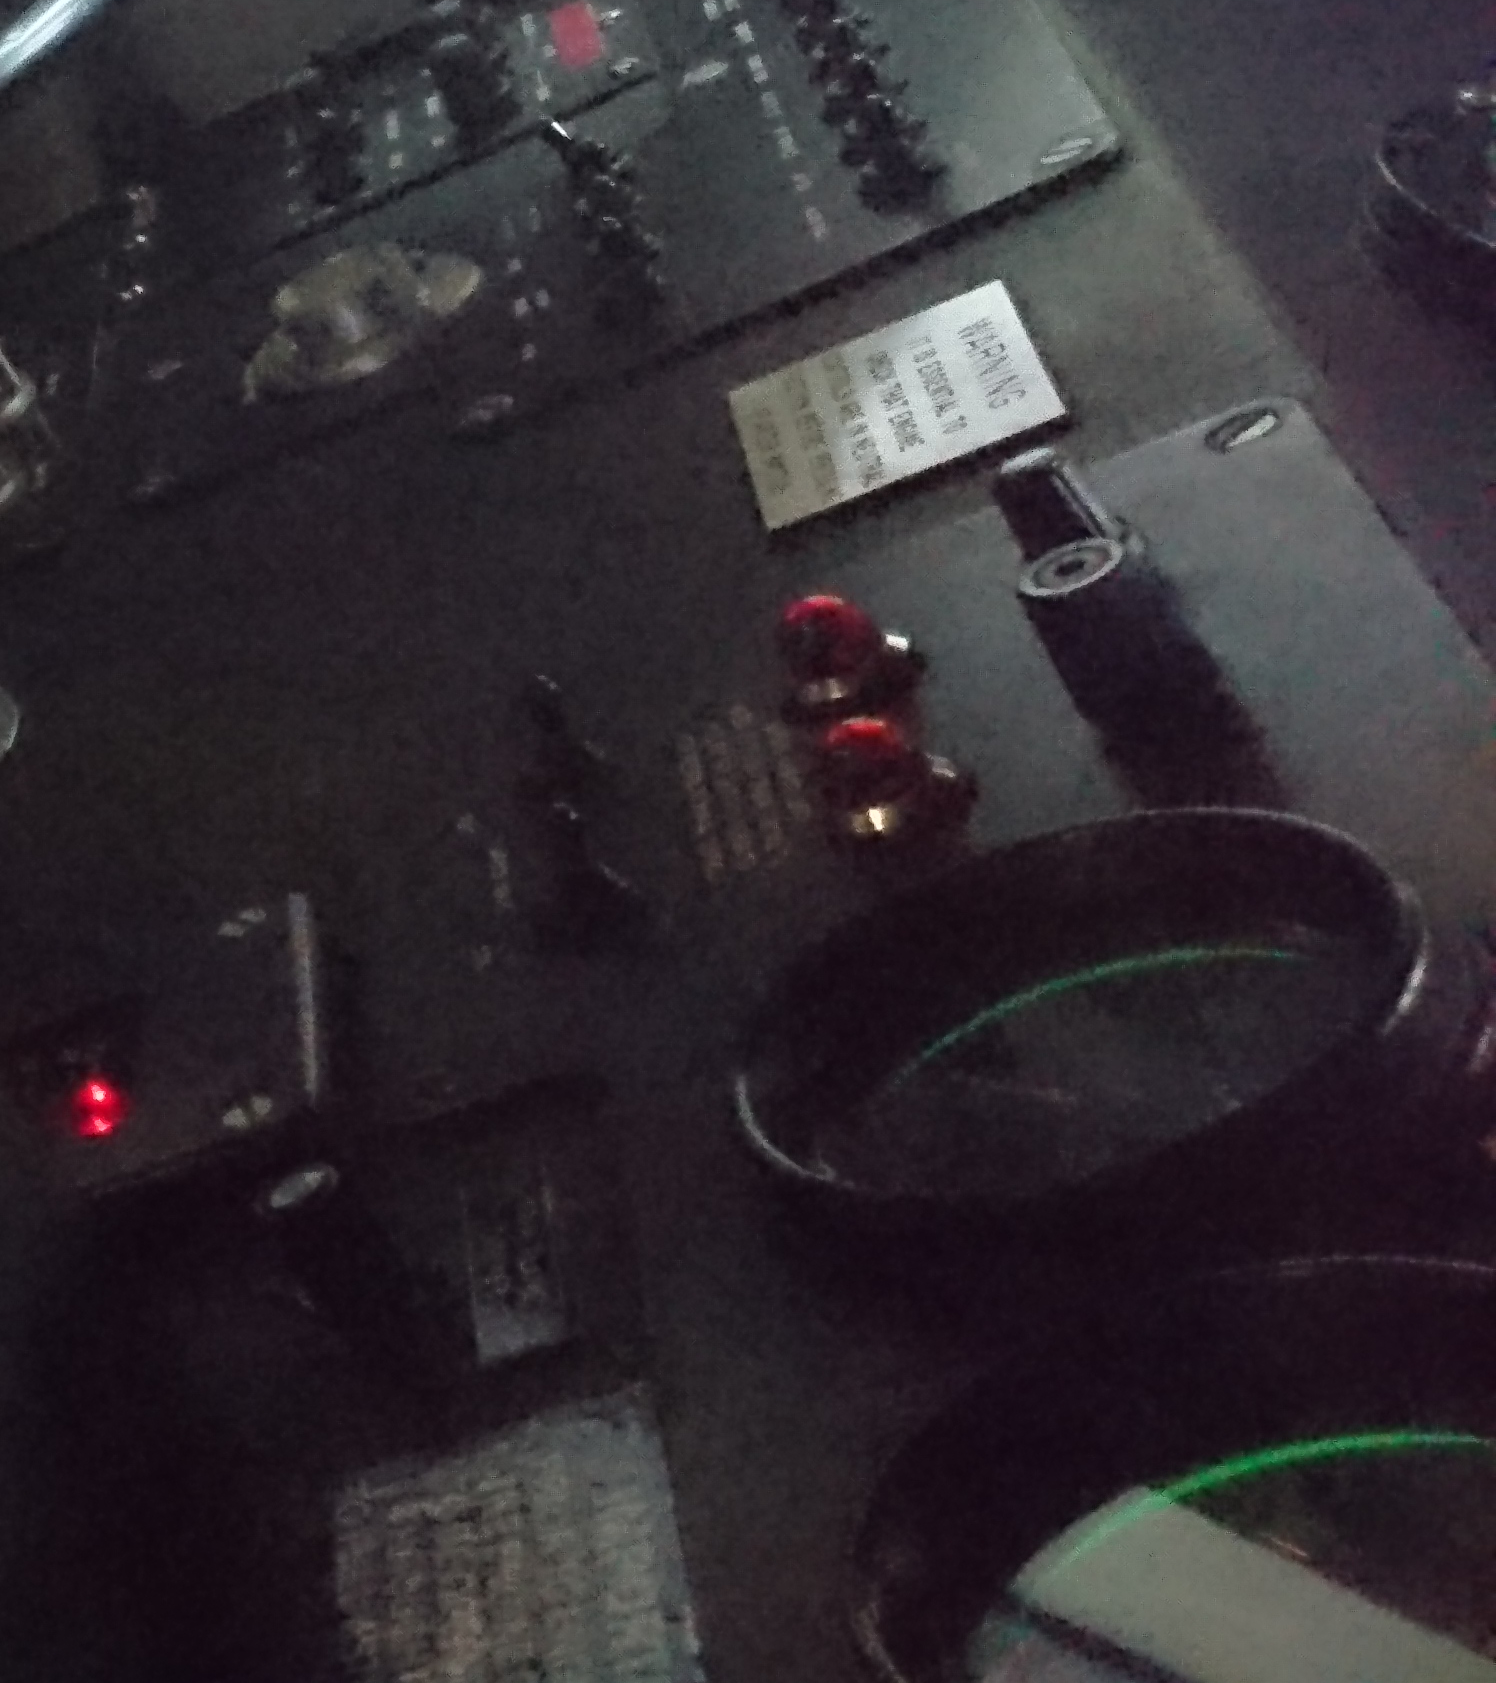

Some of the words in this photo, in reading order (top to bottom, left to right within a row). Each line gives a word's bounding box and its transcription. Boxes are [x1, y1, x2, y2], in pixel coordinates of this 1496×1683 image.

[916, 360, 958, 417] ESSENTIAL
[957, 316, 1026, 409] WARNING
[888, 410, 925, 452] ENGINE
